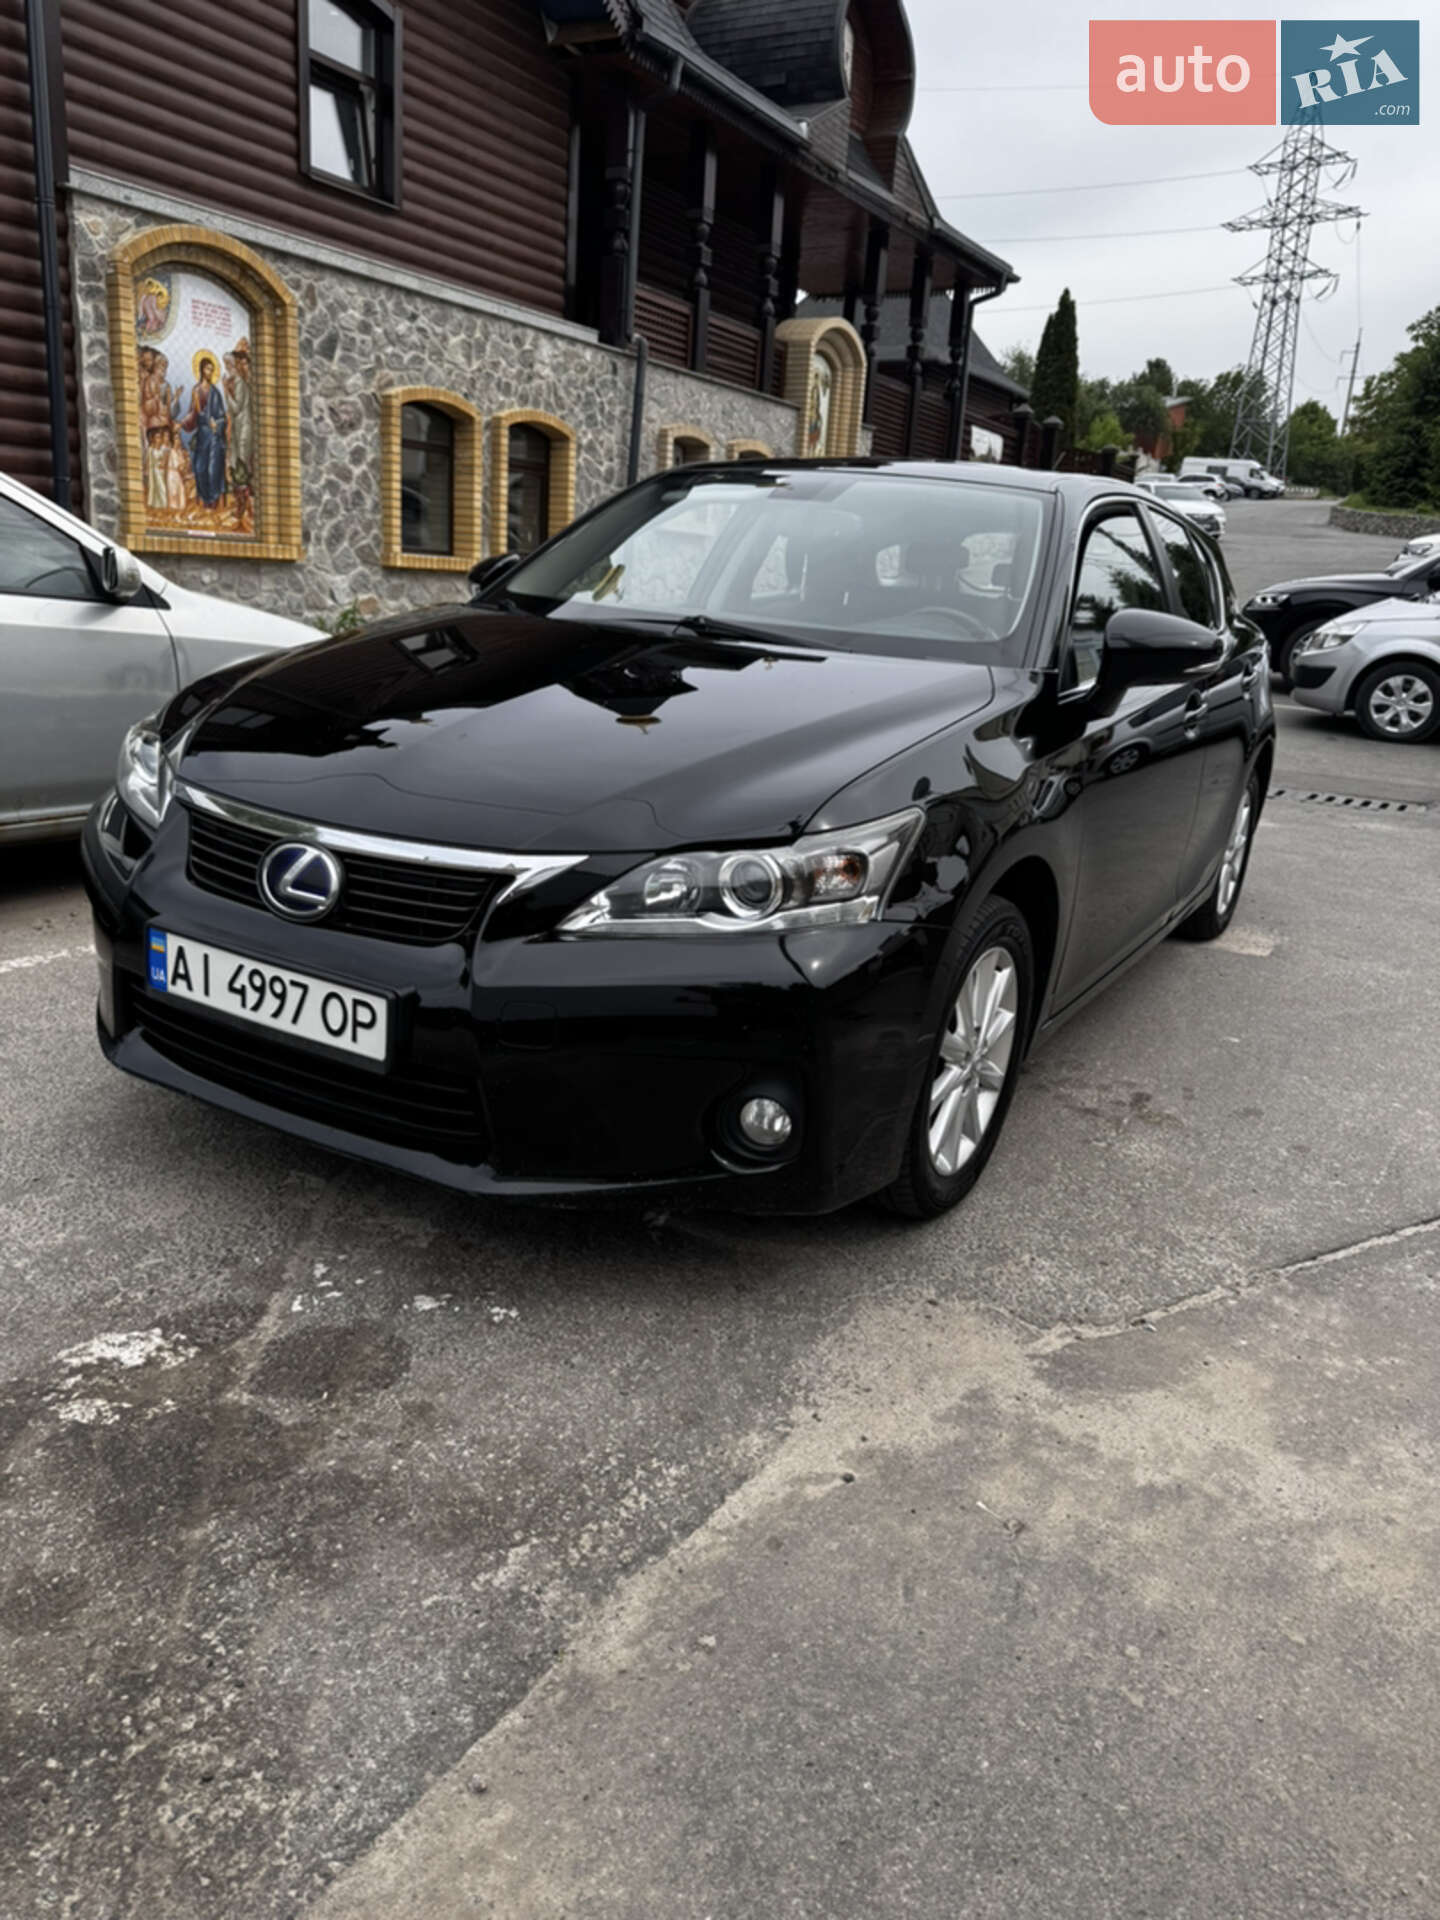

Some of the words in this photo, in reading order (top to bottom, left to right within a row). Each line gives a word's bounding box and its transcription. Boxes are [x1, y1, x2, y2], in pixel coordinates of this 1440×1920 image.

[151, 967, 166, 982] UA
[171, 945, 210, 997] AI
[228, 963, 309, 1025] 4997
[320, 991, 377, 1043] OP
